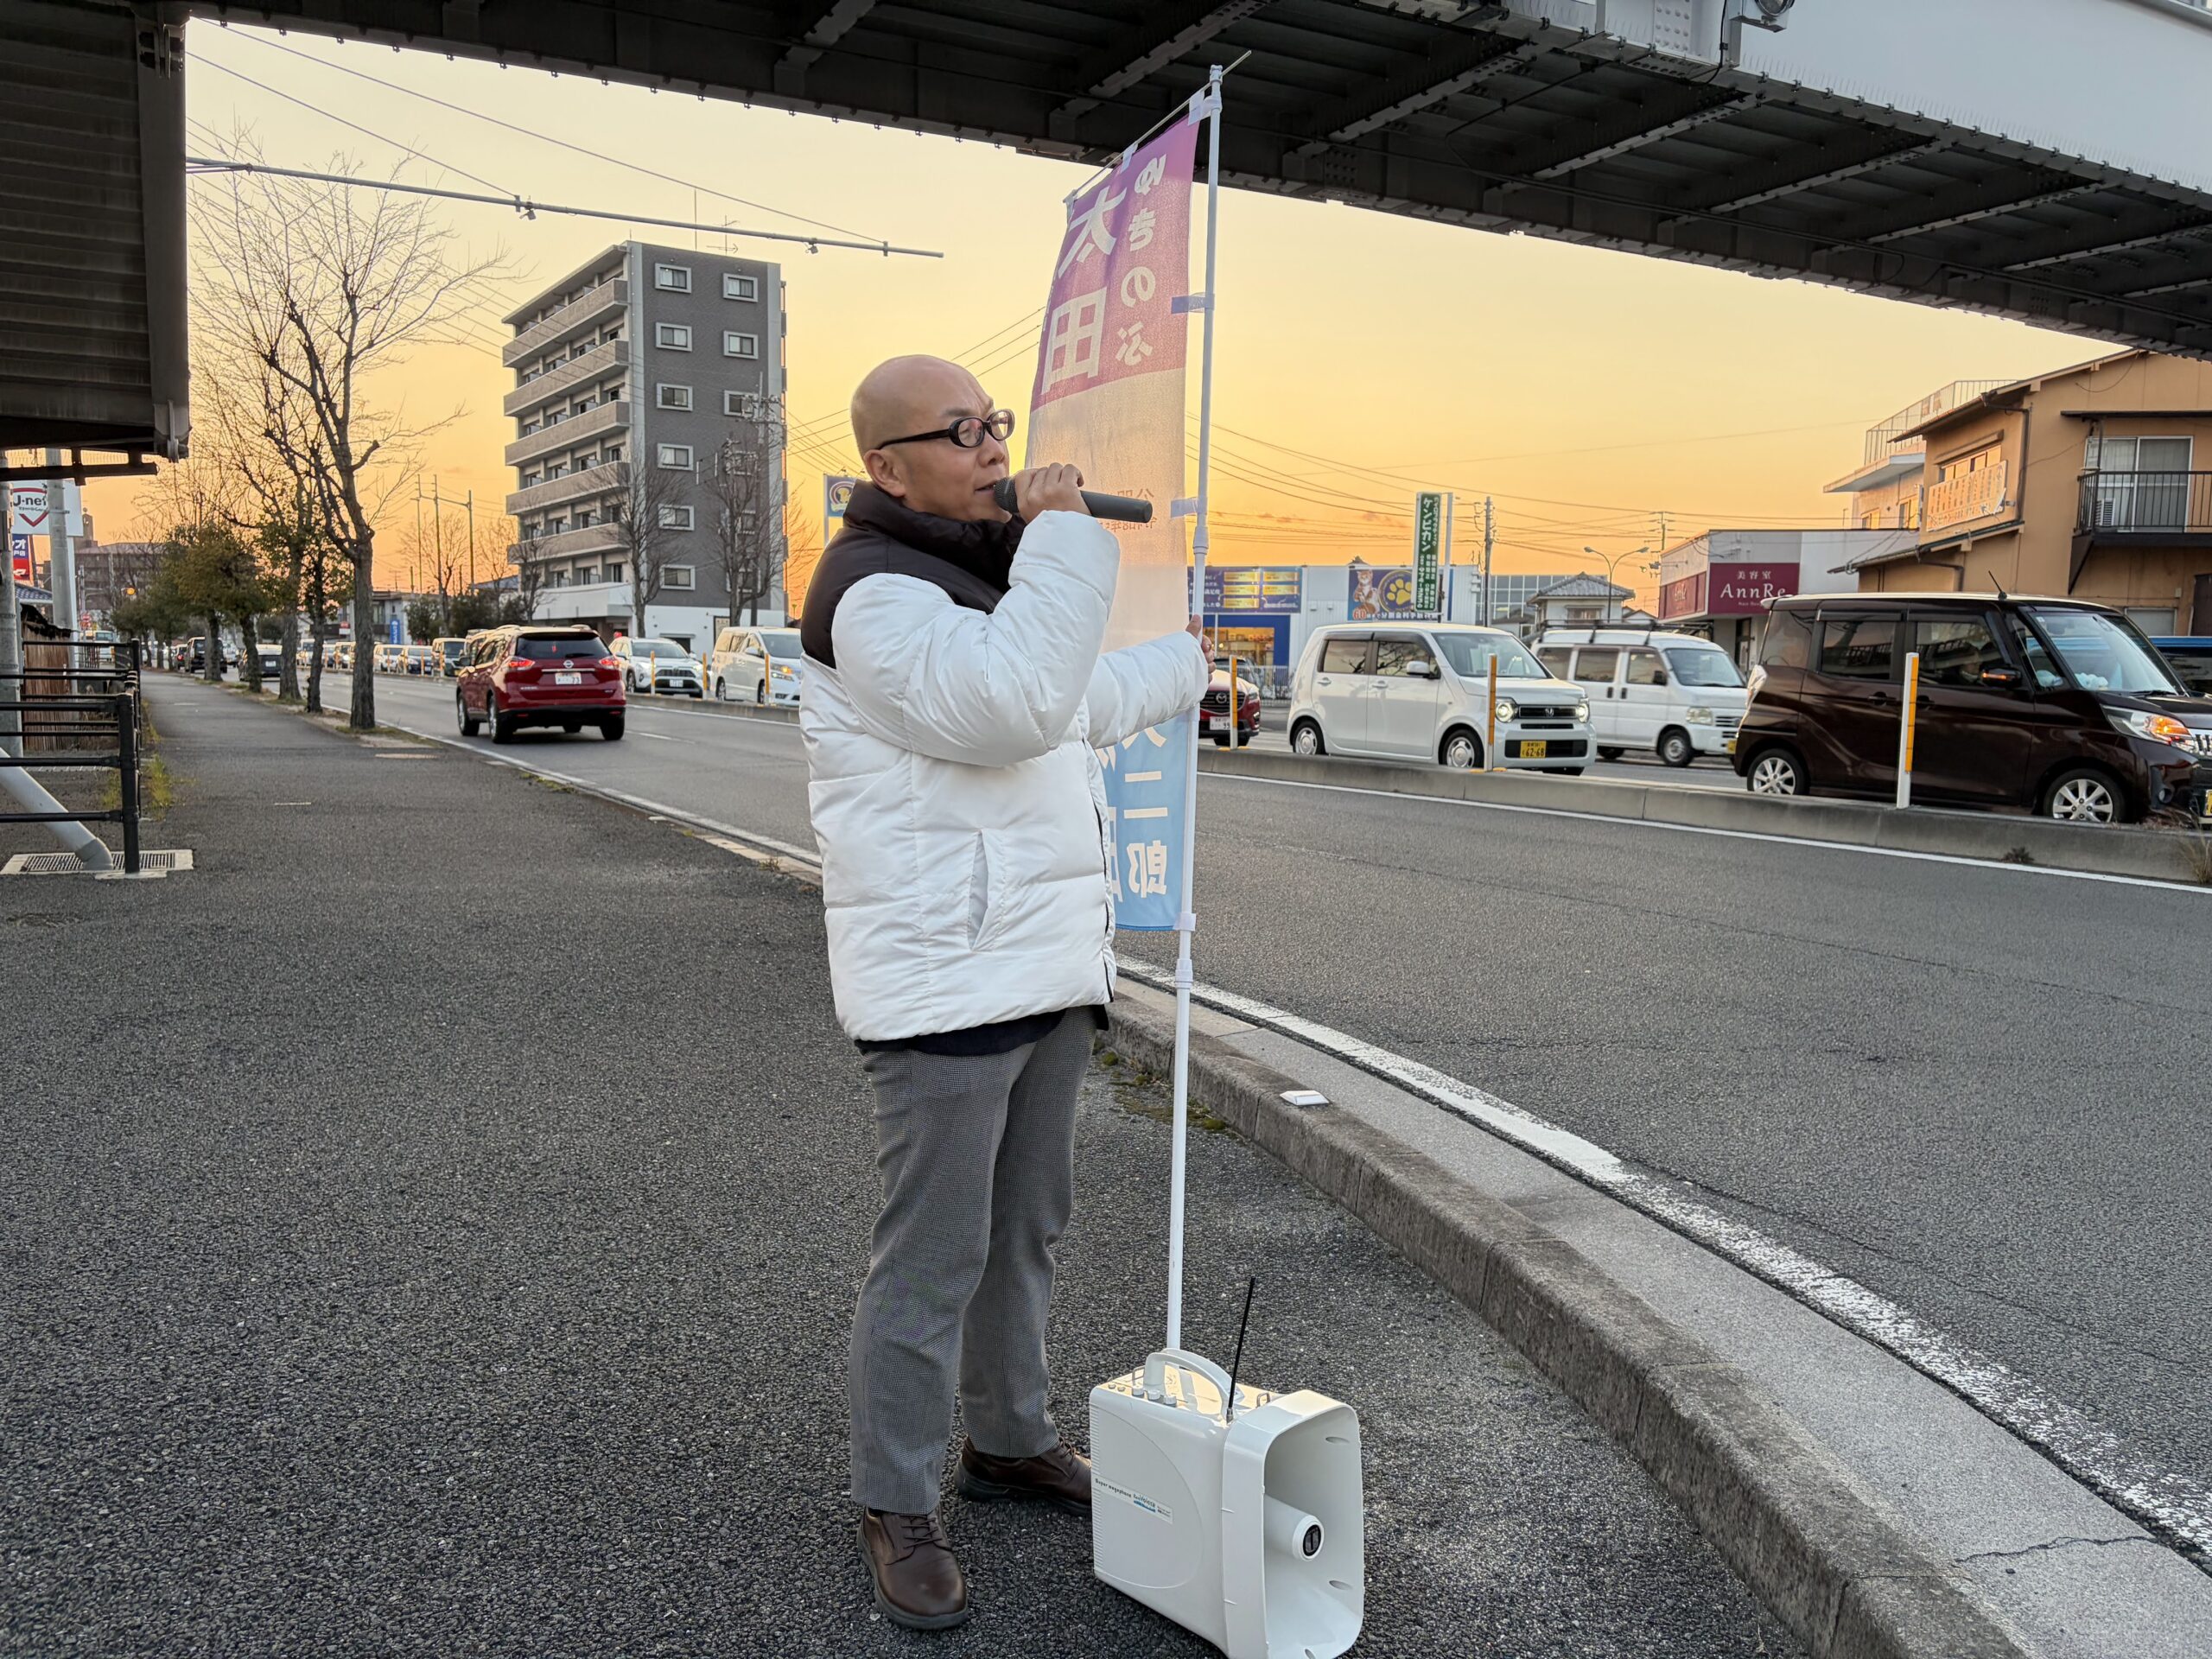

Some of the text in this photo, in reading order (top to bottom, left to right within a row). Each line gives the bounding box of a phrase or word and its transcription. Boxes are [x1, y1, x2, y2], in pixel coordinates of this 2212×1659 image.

[1737, 570, 1772, 580] 美容室
[1719, 582, 1786, 598] AnnRe
